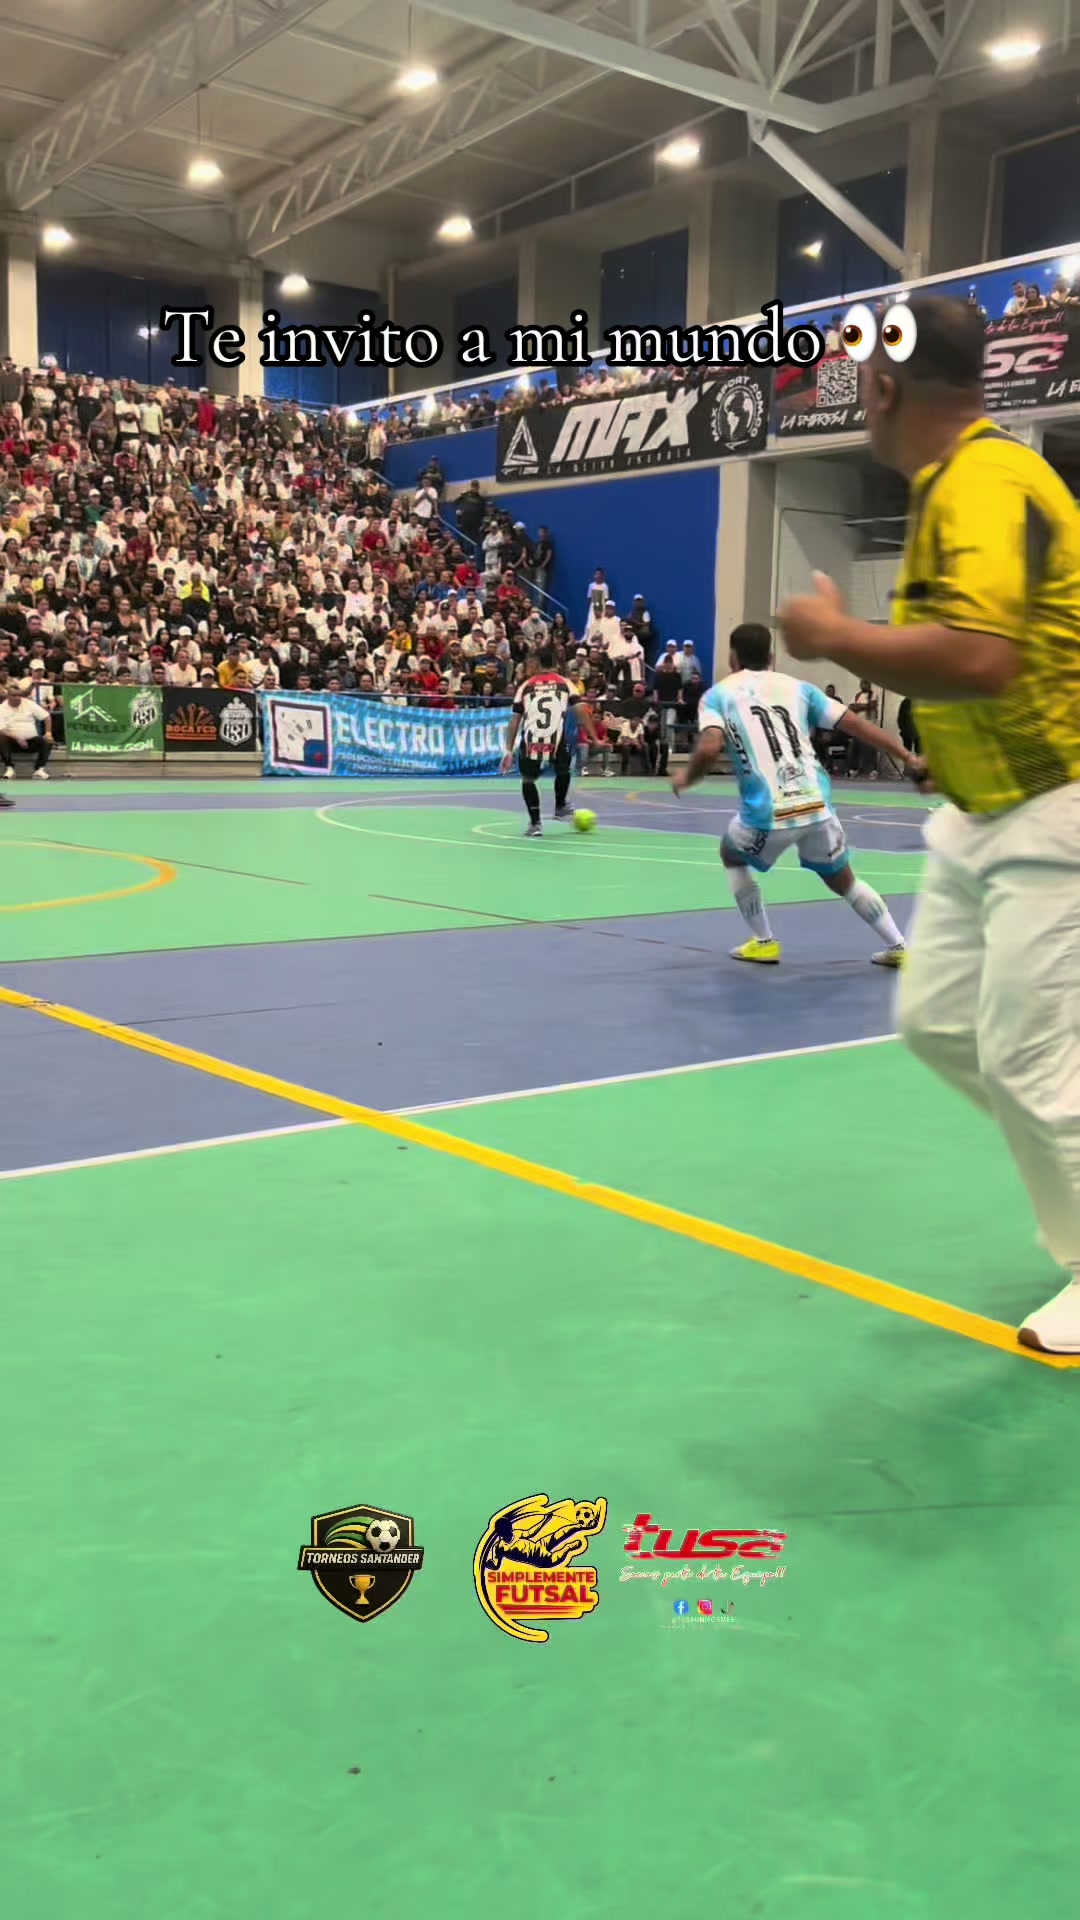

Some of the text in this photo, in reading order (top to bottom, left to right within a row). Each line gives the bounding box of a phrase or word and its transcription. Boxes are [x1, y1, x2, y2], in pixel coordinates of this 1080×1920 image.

[550, 382, 700, 463] MAX
[335, 712, 446, 755] ELECTRO
[536, 696, 553, 730] 5
[750, 704, 802, 763] 11
